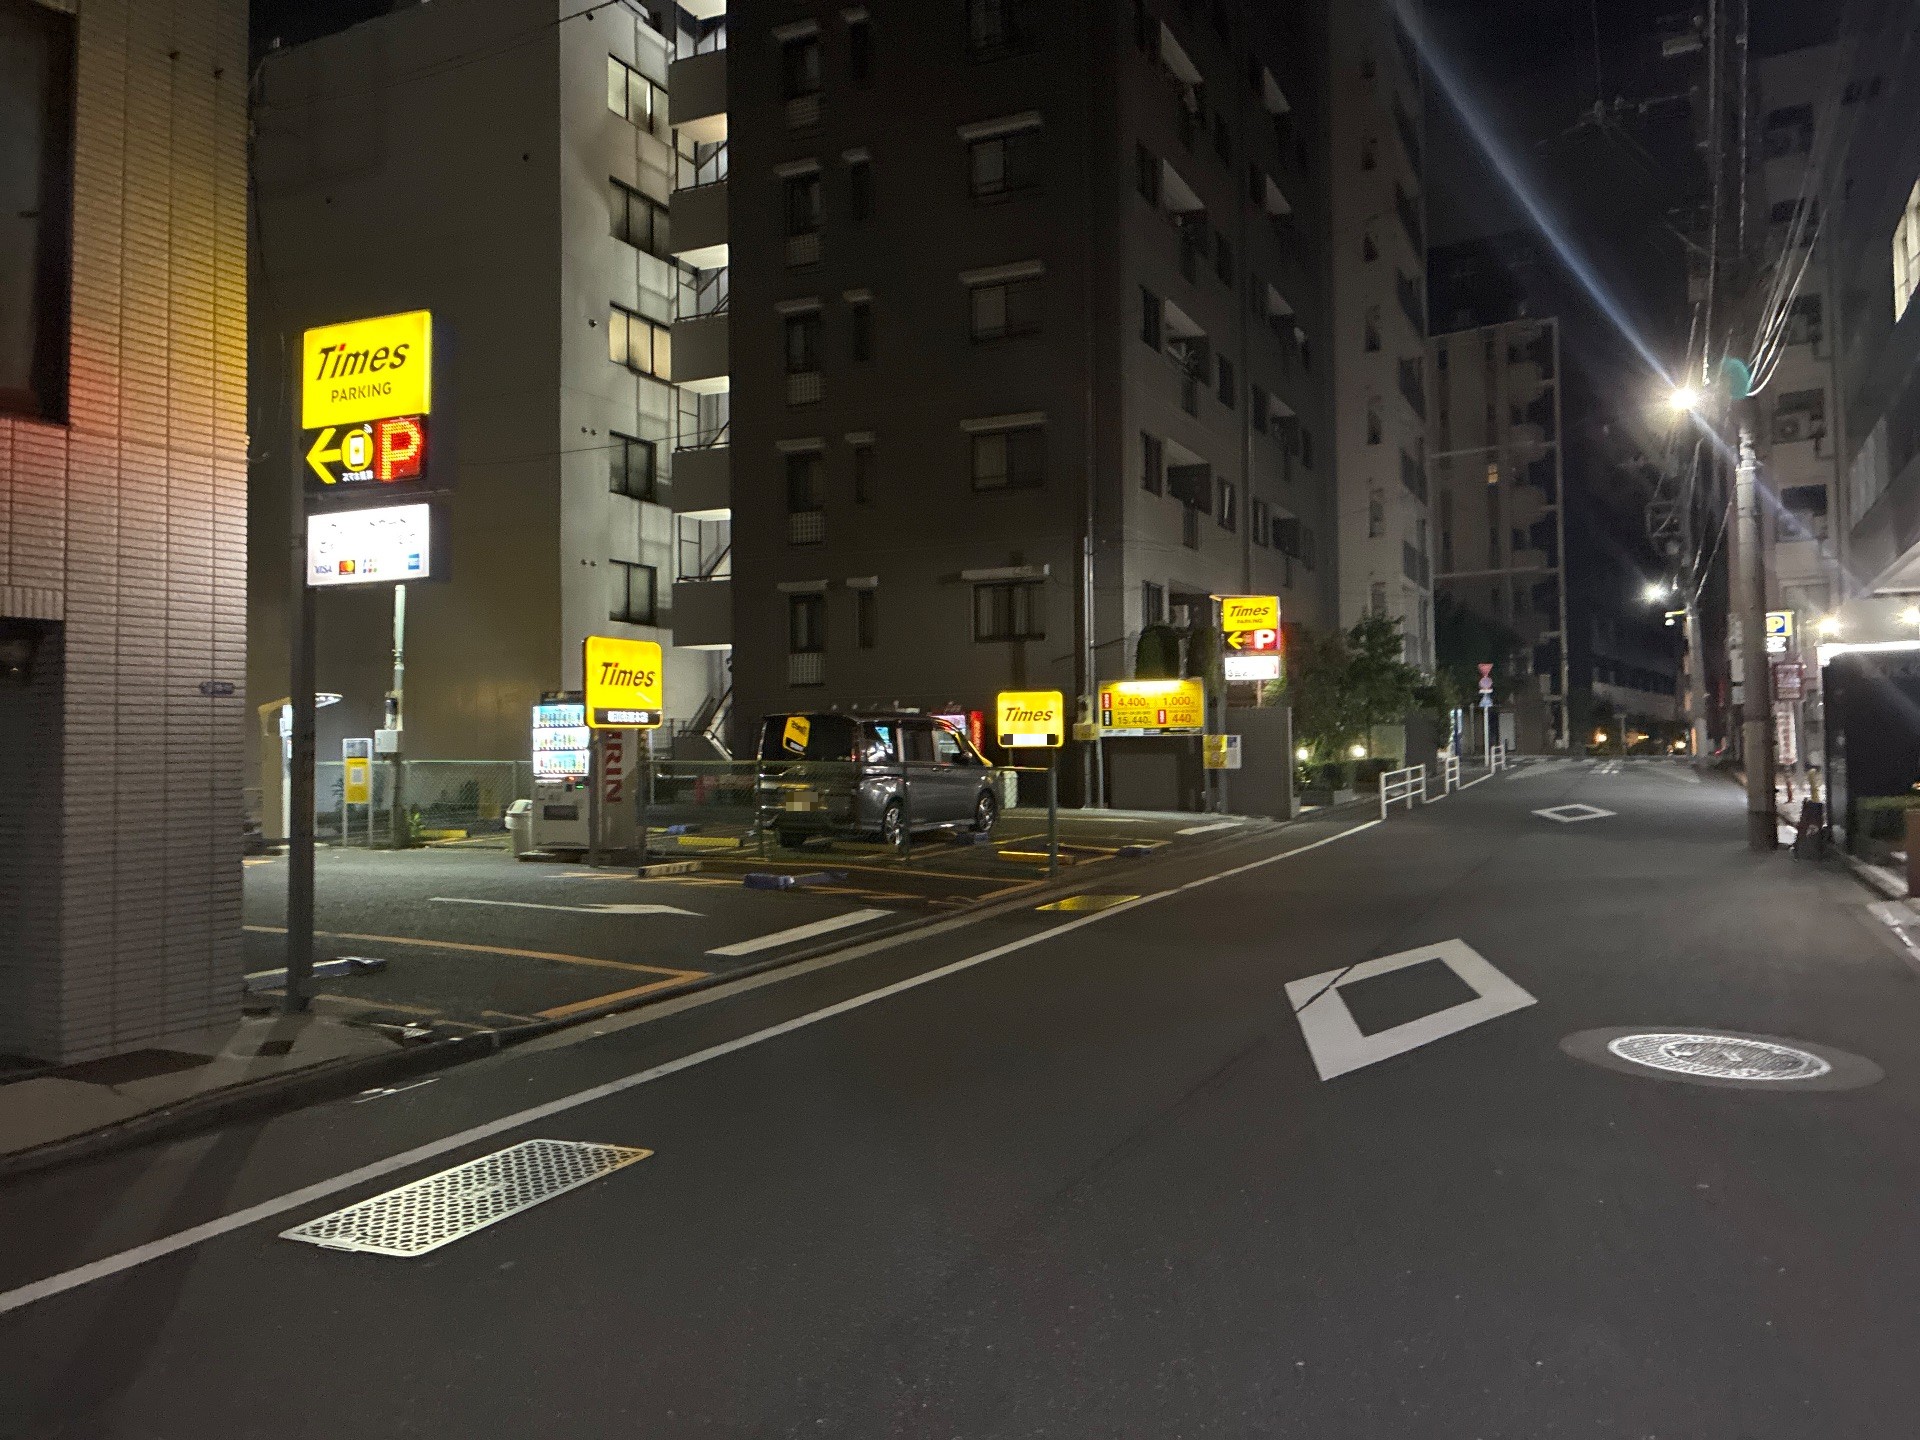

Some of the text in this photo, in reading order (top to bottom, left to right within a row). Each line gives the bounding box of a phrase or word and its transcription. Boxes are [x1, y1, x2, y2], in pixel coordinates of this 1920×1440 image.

[315, 343, 410, 380] Times
[331, 381, 392, 403] PARKING
[381, 421, 420, 480] P
[1230, 605, 1270, 617] Times
[1254, 629, 1276, 649] P
[600, 662, 656, 687] Times
[1005, 707, 1053, 721] Times
[606, 731, 622, 803] IRIN
